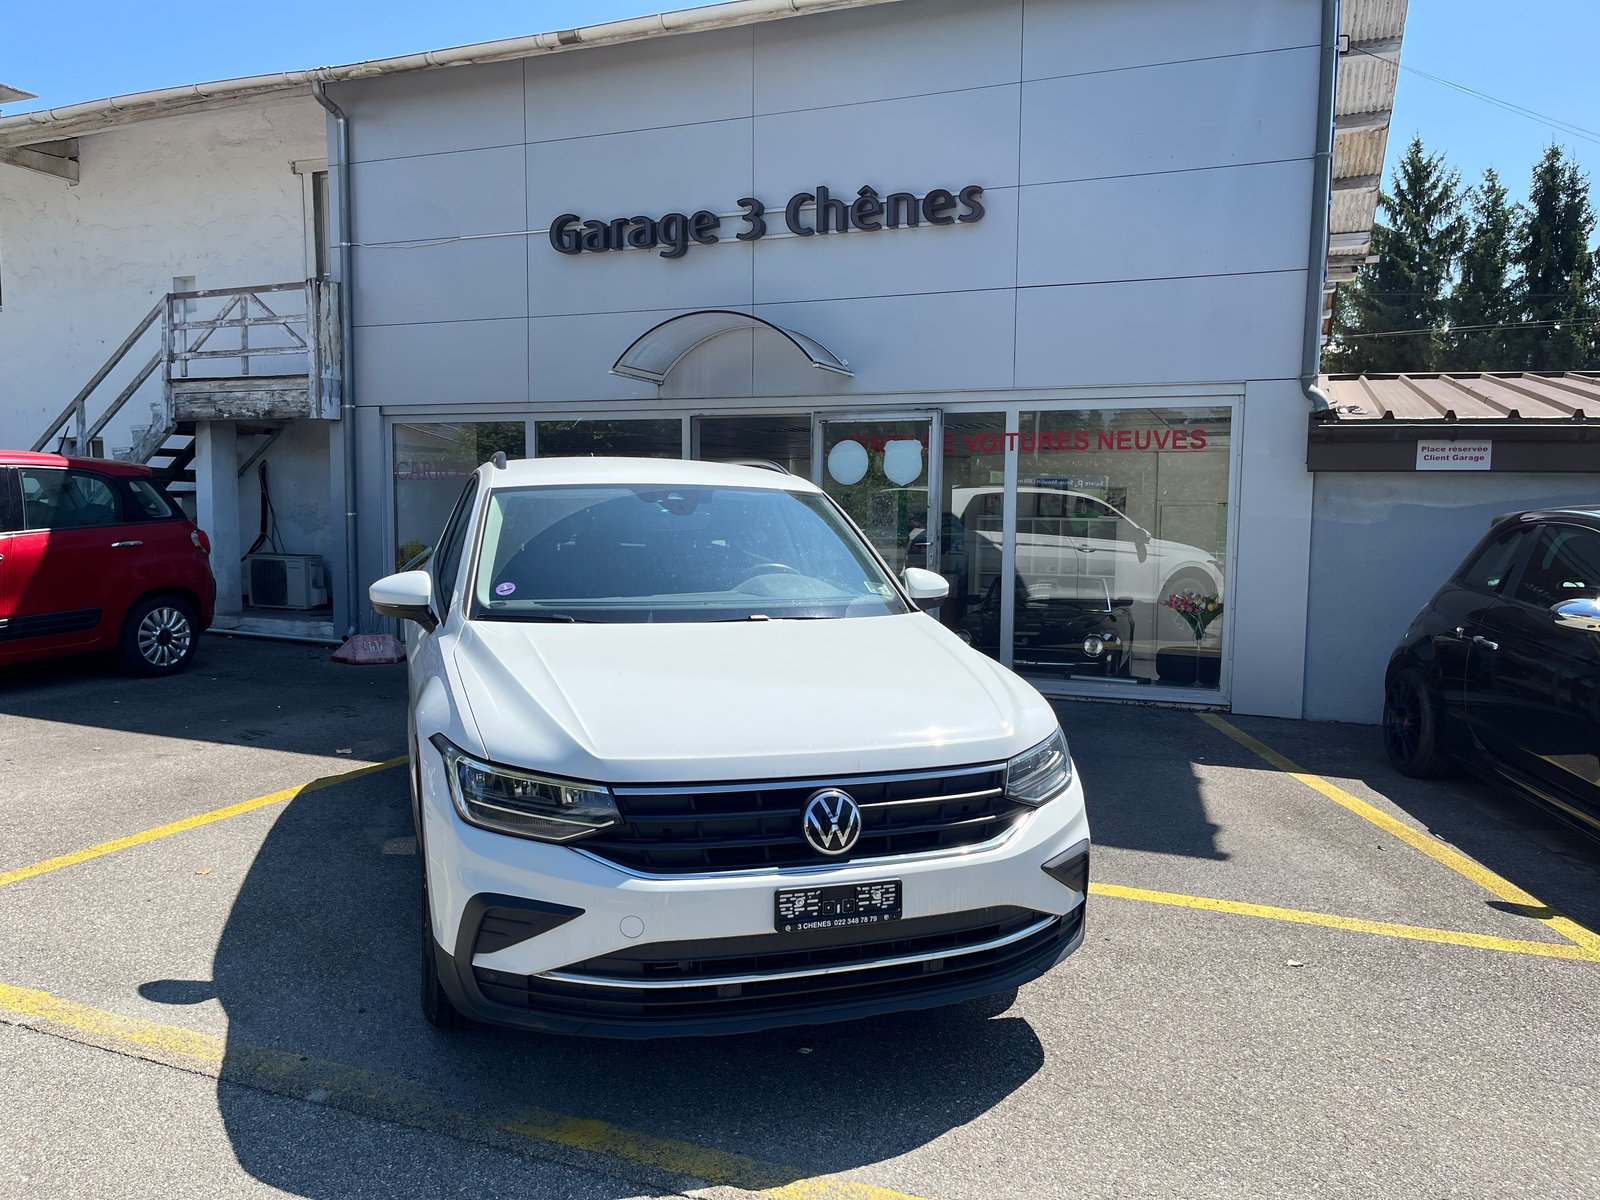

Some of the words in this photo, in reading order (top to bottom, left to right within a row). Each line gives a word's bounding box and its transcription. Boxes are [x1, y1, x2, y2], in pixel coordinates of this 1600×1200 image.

[549, 209, 720, 259] Garage
[736, 197, 766, 241] 3
[785, 184, 985, 237] Chênes
[963, 431, 1089, 452] VOITURES
[1097, 429, 1207, 450] NEUVES
[1452, 454, 1485, 462] Garage
[806, 791, 859, 852] VW
[803, 920, 831, 929] CHENES
[847, 917, 859, 925] 348
